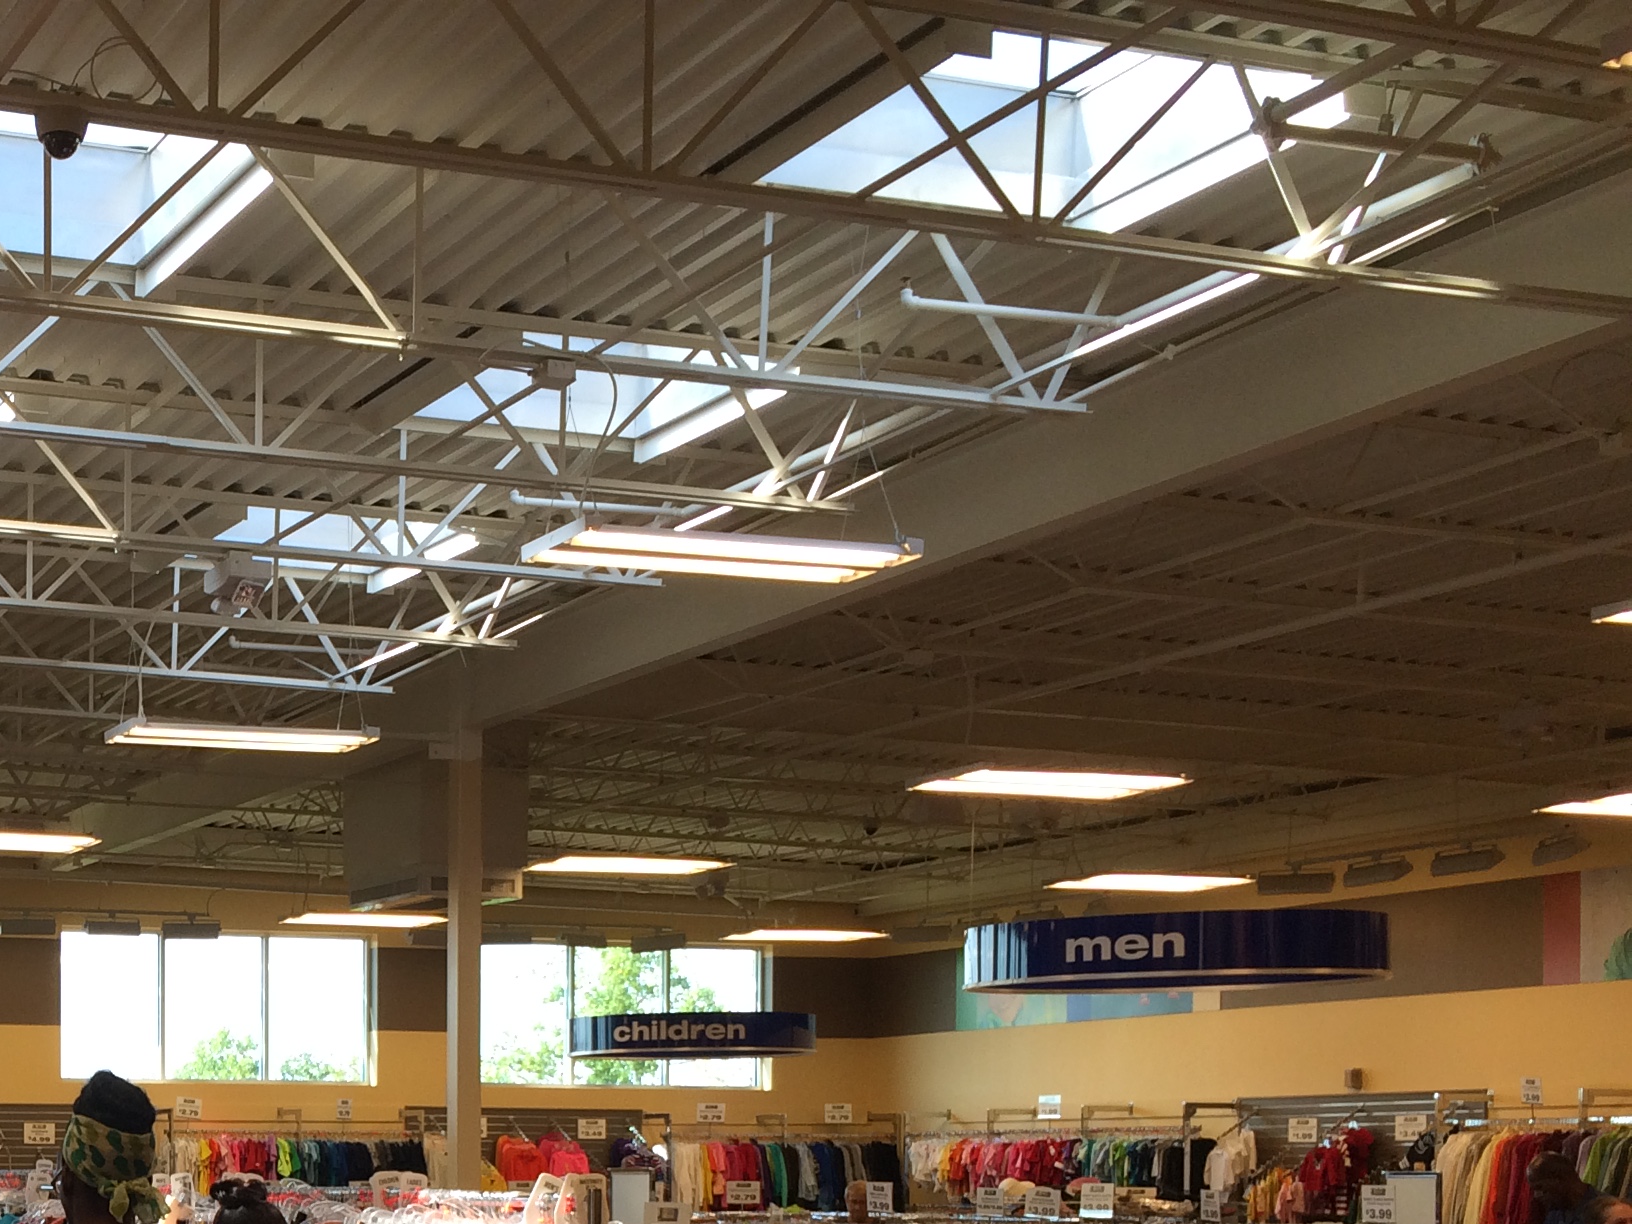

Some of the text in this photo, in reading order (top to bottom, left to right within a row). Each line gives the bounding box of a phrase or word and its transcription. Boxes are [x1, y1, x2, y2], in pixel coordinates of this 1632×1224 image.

[1065, 931, 1185, 963] men
[613, 1019, 746, 1042] children
[178, 1109, 199, 1117] $2.79
[730, 1193, 757, 1201] $2.79
[869, 1201, 890, 1211] $3.99
[1028, 1206, 1056, 1216] $3.99
[1365, 1208, 1392, 1220] $3.99
